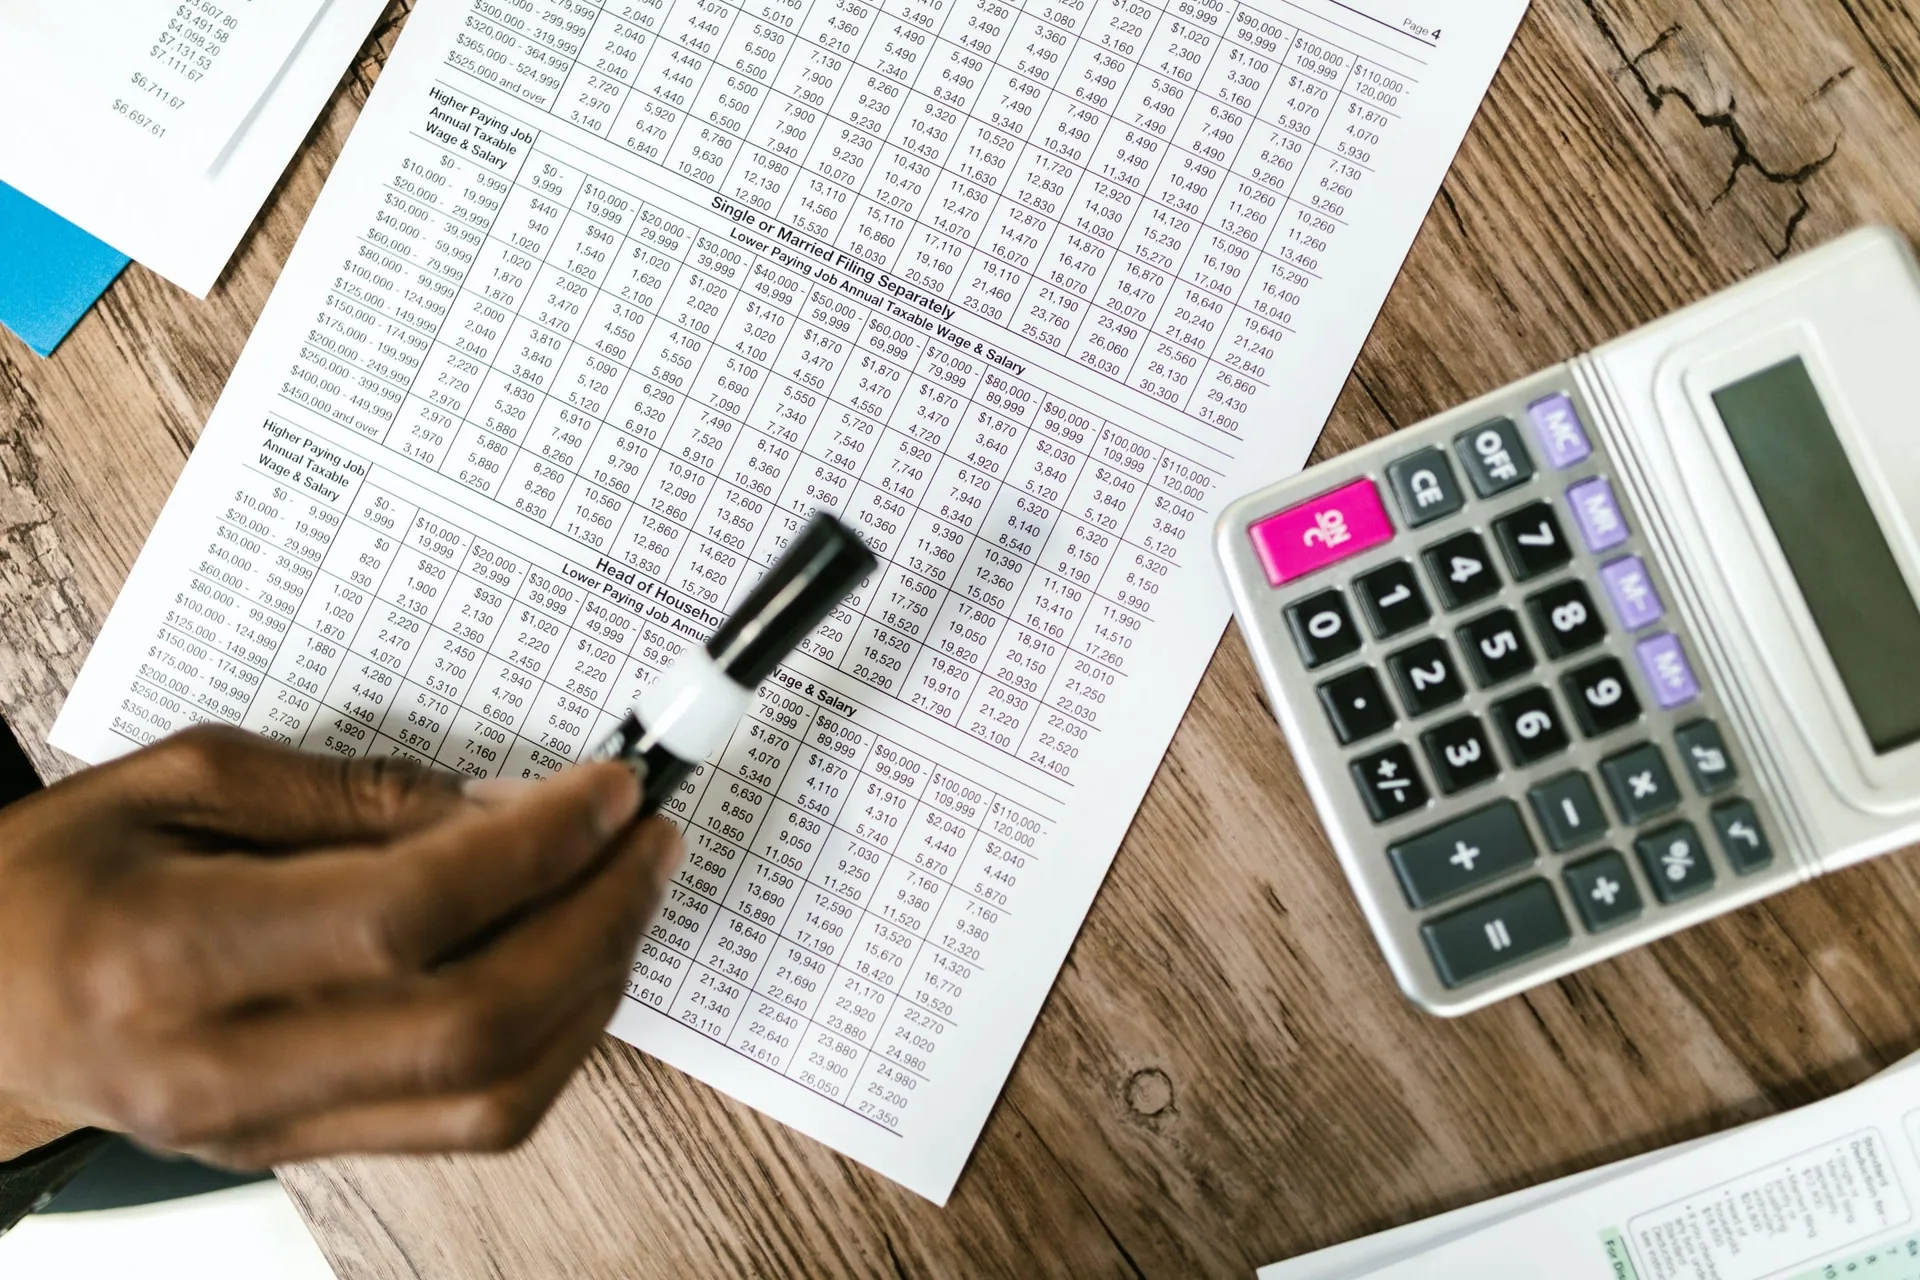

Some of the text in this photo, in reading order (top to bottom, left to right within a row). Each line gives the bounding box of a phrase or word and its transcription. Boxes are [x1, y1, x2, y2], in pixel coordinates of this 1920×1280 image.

[168, 18, 221, 56] $4,098.20
[176, 4, 230, 43] $3,491.58
[473, 0, 578, 55] $300,000 319,999
[1034, 25, 1067, 46] 3,360
[1236, 11, 1282, 39] $90,000
[1401, 17, 1442, 40] Page 4
[158, 31, 212, 70] $7,131.53
[1237, 28, 1277, 53] 99,999
[1294, 37, 1343, 67] $100,000
[150, 45, 204, 83] $7,111.67
[447, 50, 546, 104] $525,000 and over
[1296, 55, 1338, 80] 109,999
[131, 72, 185, 110] $6,711.67
[933, 85, 965, 107] 8,340
[1288, 75, 1328, 100] $1,870
[1356, 81, 1397, 107] 120,000
[112, 98, 166, 138] $6,697.61
[428, 86, 533, 144] Higher Paying Job
[1347, 102, 1388, 127] $1,870
[428, 106, 517, 155] Annual Taxable
[635, 119, 667, 140] 6,470
[700, 128, 732, 149] 8,780
[1346, 124, 1379, 145] 4,070
[426, 120, 508, 170] Wage & Salary
[1337, 141, 1370, 163] 5,930
[1260, 149, 1293, 171] 8,260
[401, 157, 499, 211] $10,000 19,999
[583, 183, 628, 211] $10,000
[529, 198, 558, 218] $440
[586, 200, 622, 224] 19,999
[527, 219, 549, 236] 940
[585, 224, 614, 245] $940
[640, 210, 685, 238] $20,000
[1297, 210, 1335, 234] 10,260
[640, 227, 679, 251] 29,999
[711, 195, 956, 321] Single or Married Filing Separately
[753, 263, 799, 292] $40,000
[1271, 263, 1309, 288] 15,290
[729, 226, 1026, 376] Lower Paying Job Annual Taxable Wage & Salary
[754, 281, 793, 305] 49,999
[1254, 299, 1291, 324] 18,040
[868, 318, 914, 347] $60,000
[307, 329, 410, 386] $200,000 249,999
[869, 335, 908, 360] 69,999
[446, 354, 478, 376] 2,220
[1080, 350, 1120, 376] 28,030
[1224, 352, 1265, 377] 22,840
[984, 373, 1031, 402] $80,000
[1216, 370, 1256, 395] 26,860
[281, 381, 378, 436] $450,000 and over
[986, 391, 1025, 416] 89,999
[1199, 406, 1239, 431] 31,800
[1544, 410, 1580, 454] MC
[262, 418, 365, 476] Higher Paying Job
[1101, 429, 1151, 459] $100,000
[1476, 431, 1517, 480] OFF
[262, 438, 349, 487] Annual Taxable
[1103, 446, 1145, 473] 109,999
[1161, 457, 1210, 487] $110,000
[259, 453, 340, 502] Wage & Salary
[1163, 474, 1204, 501] 120,000
[1411, 469, 1443, 508] CE
[515, 497, 547, 519] 8,830
[717, 507, 754, 532] 13,850
[1154, 496, 1194, 522] $2,040
[1581, 491, 1615, 534] MR
[415, 516, 460, 545] $10,000
[1152, 517, 1185, 540] 3,840
[1303, 528, 1323, 547] C
[1315, 509, 1351, 548] ON
[1518, 522, 1554, 546] 7
[374, 537, 390, 552] $0
[359, 552, 381, 569] 820
[985, 548, 1023, 574] 10,390
[1135, 554, 1168, 576] 6,320
[1451, 556, 1482, 582] 4
[473, 587, 502, 608] $930
[528, 572, 573, 601] $30,000
[595, 557, 725, 629] Head of Househol
[681, 578, 718, 603] 15,790
[1379, 584, 1411, 607] 1
[561, 562, 713, 644] Lower Paying Job Annua
[1551, 600, 1586, 632] 8
[586, 619, 624, 643] 49,999
[1308, 611, 1341, 638] 0
[1481, 630, 1518, 659] 5
[852, 663, 893, 690] 20,290
[1410, 660, 1446, 690] 2
[1654, 650, 1684, 689] M+
[757, 686, 804, 716] $70,000
[804, 683, 815, 697] &
[816, 689, 857, 718] Salary
[1586, 678, 1622, 706] 9
[333, 719, 366, 740] 4,920
[1047, 714, 1088, 740] 22,030
[1515, 709, 1552, 738] 6
[816, 732, 856, 758] 89,999
[1445, 739, 1481, 767] 3
[985, 842, 1025, 868] $2,040
[1661, 840, 1694, 881] %
[680, 870, 718, 897] 14,690
[717, 936, 758, 963] 20,390
[933, 953, 971, 979] 14,320
